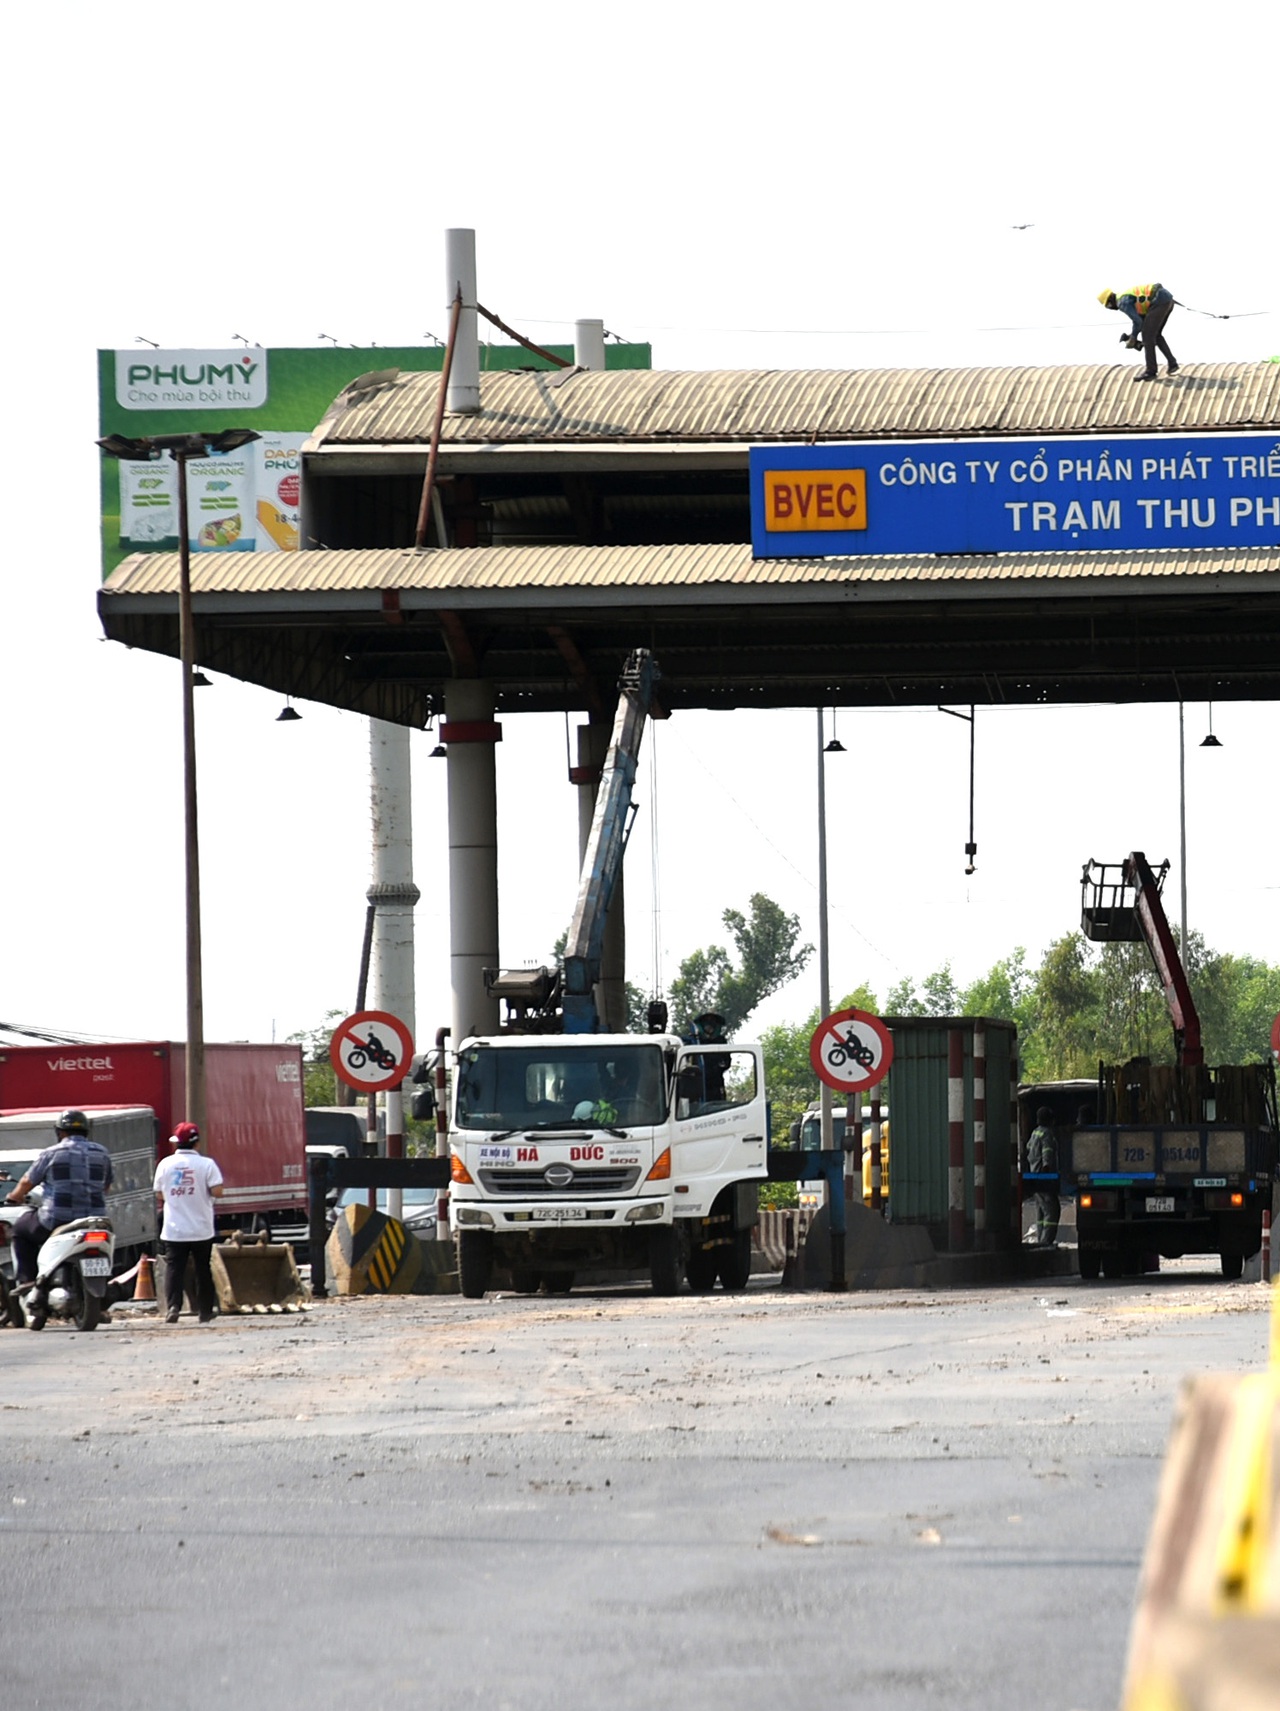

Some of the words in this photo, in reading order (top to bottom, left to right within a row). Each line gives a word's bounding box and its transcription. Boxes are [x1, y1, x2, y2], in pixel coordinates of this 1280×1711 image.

[127, 389, 158, 402] Cho
[162, 389, 194, 401] mùa
[199, 389, 222, 402] bội
[226, 389, 250, 401] thu
[879, 457, 957, 486] CÔNG
[965, 461, 1000, 483] TY
[1010, 447, 1049, 483] CỔ
[1058, 450, 1133, 482] PHẦN
[1142, 451, 1213, 480] PHÁT
[773, 483, 858, 519] BVEC
[1004, 499, 1122, 538] TRẠM
[1136, 497, 1217, 529] THU
[47, 1056, 115, 1071] viettel
[517, 1145, 539, 1162] HÀ
[570, 1143, 605, 1161] ĐỨC
